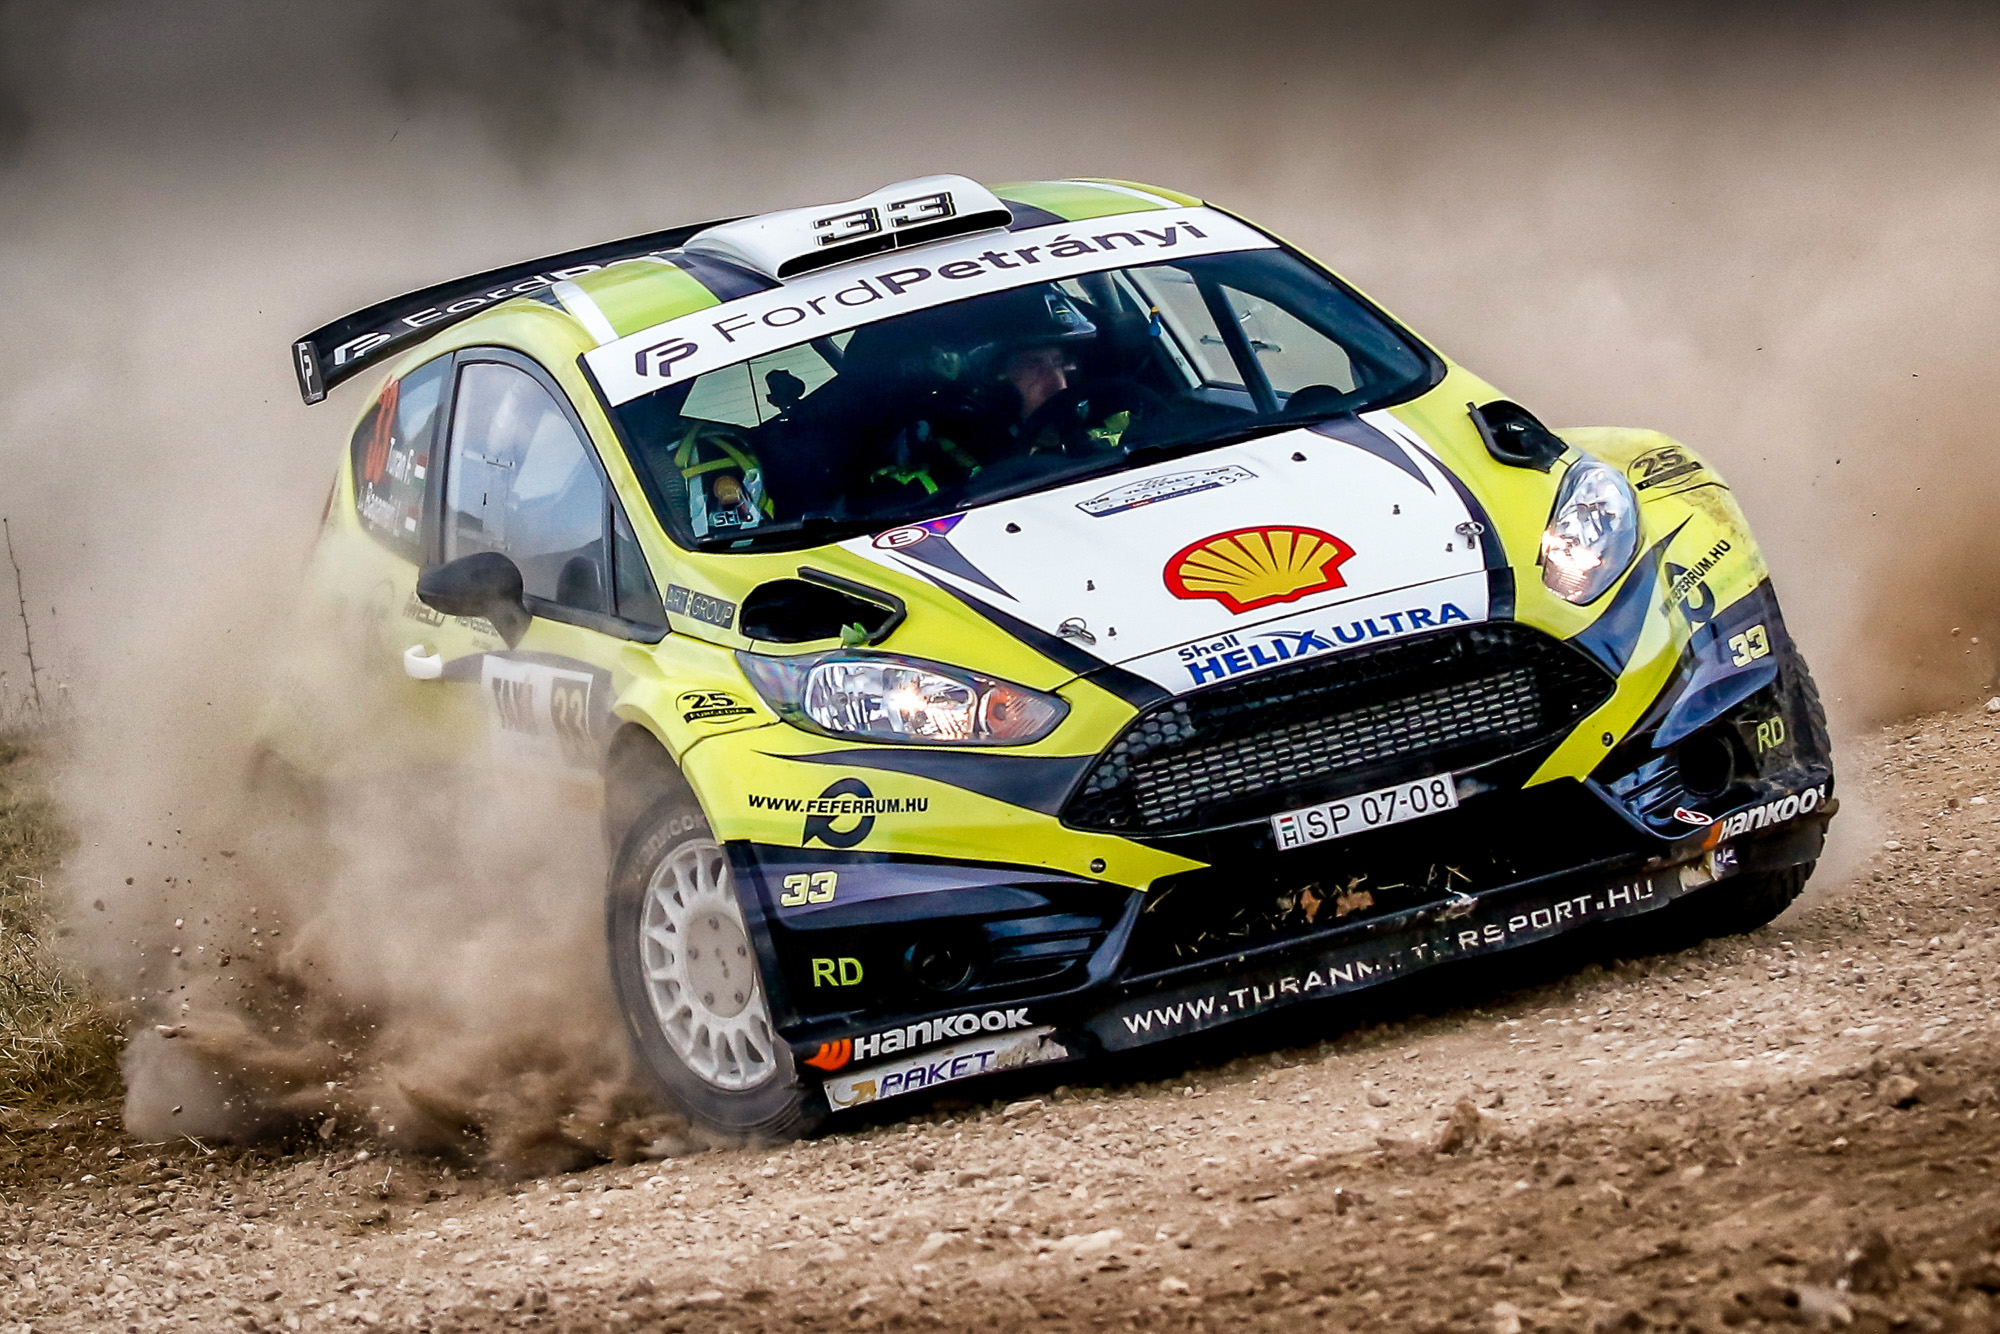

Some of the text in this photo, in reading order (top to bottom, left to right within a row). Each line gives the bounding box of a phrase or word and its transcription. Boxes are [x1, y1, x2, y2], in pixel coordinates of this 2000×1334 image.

[811, 191, 958, 246] 33
[712, 220, 1209, 343] FordPetrányi
[1633, 448, 1686, 478] 25
[887, 531, 912, 546] E
[691, 596, 734, 627] GROUP
[1178, 634, 1241, 662] Shell
[1184, 602, 1471, 686] HELIX ULTRA
[1728, 624, 1770, 668] 33
[682, 692, 738, 709] 25
[1756, 715, 1785, 754] RD
[748, 795, 929, 813] WWW.FEFERRUM.HU
[1283, 779, 1448, 847] H SP 07-08
[781, 870, 838, 907] 33
[811, 957, 864, 988] RD
